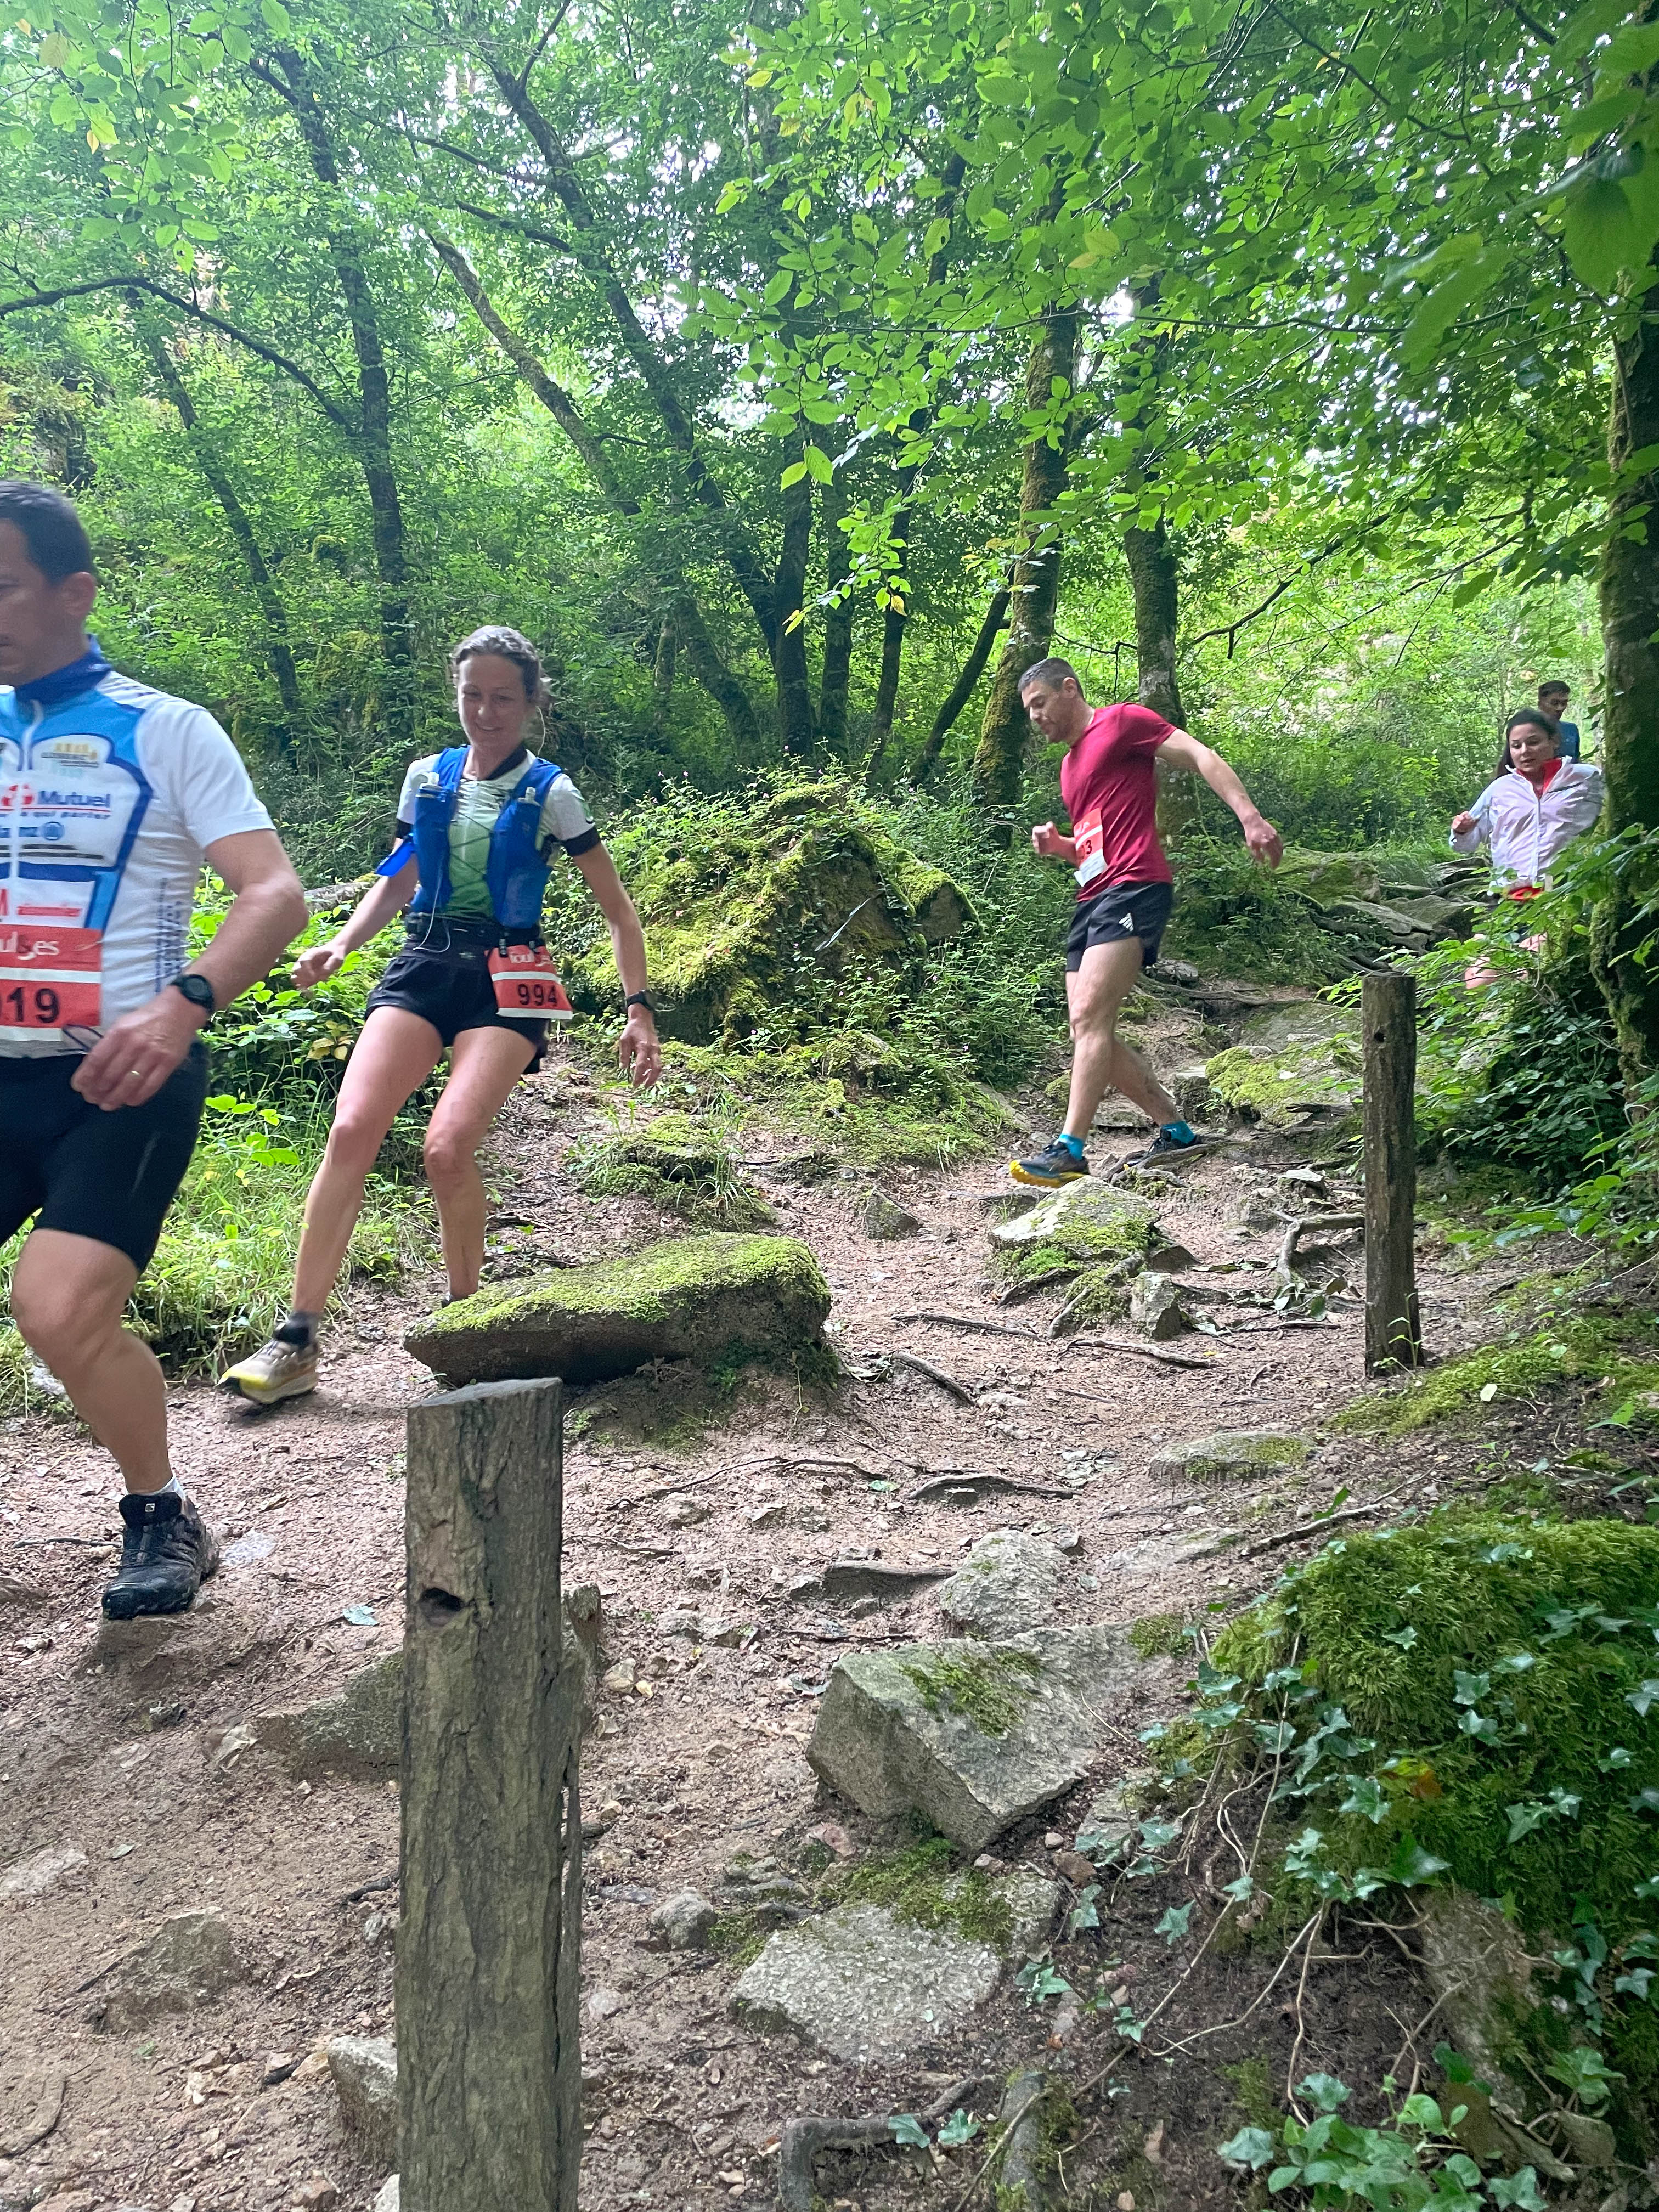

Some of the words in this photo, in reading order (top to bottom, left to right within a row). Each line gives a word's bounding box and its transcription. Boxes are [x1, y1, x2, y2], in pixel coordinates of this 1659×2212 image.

[38, 791, 111, 808] Mutuel
[0, 987, 60, 1023] 19
[517, 984, 557, 1006] 994
